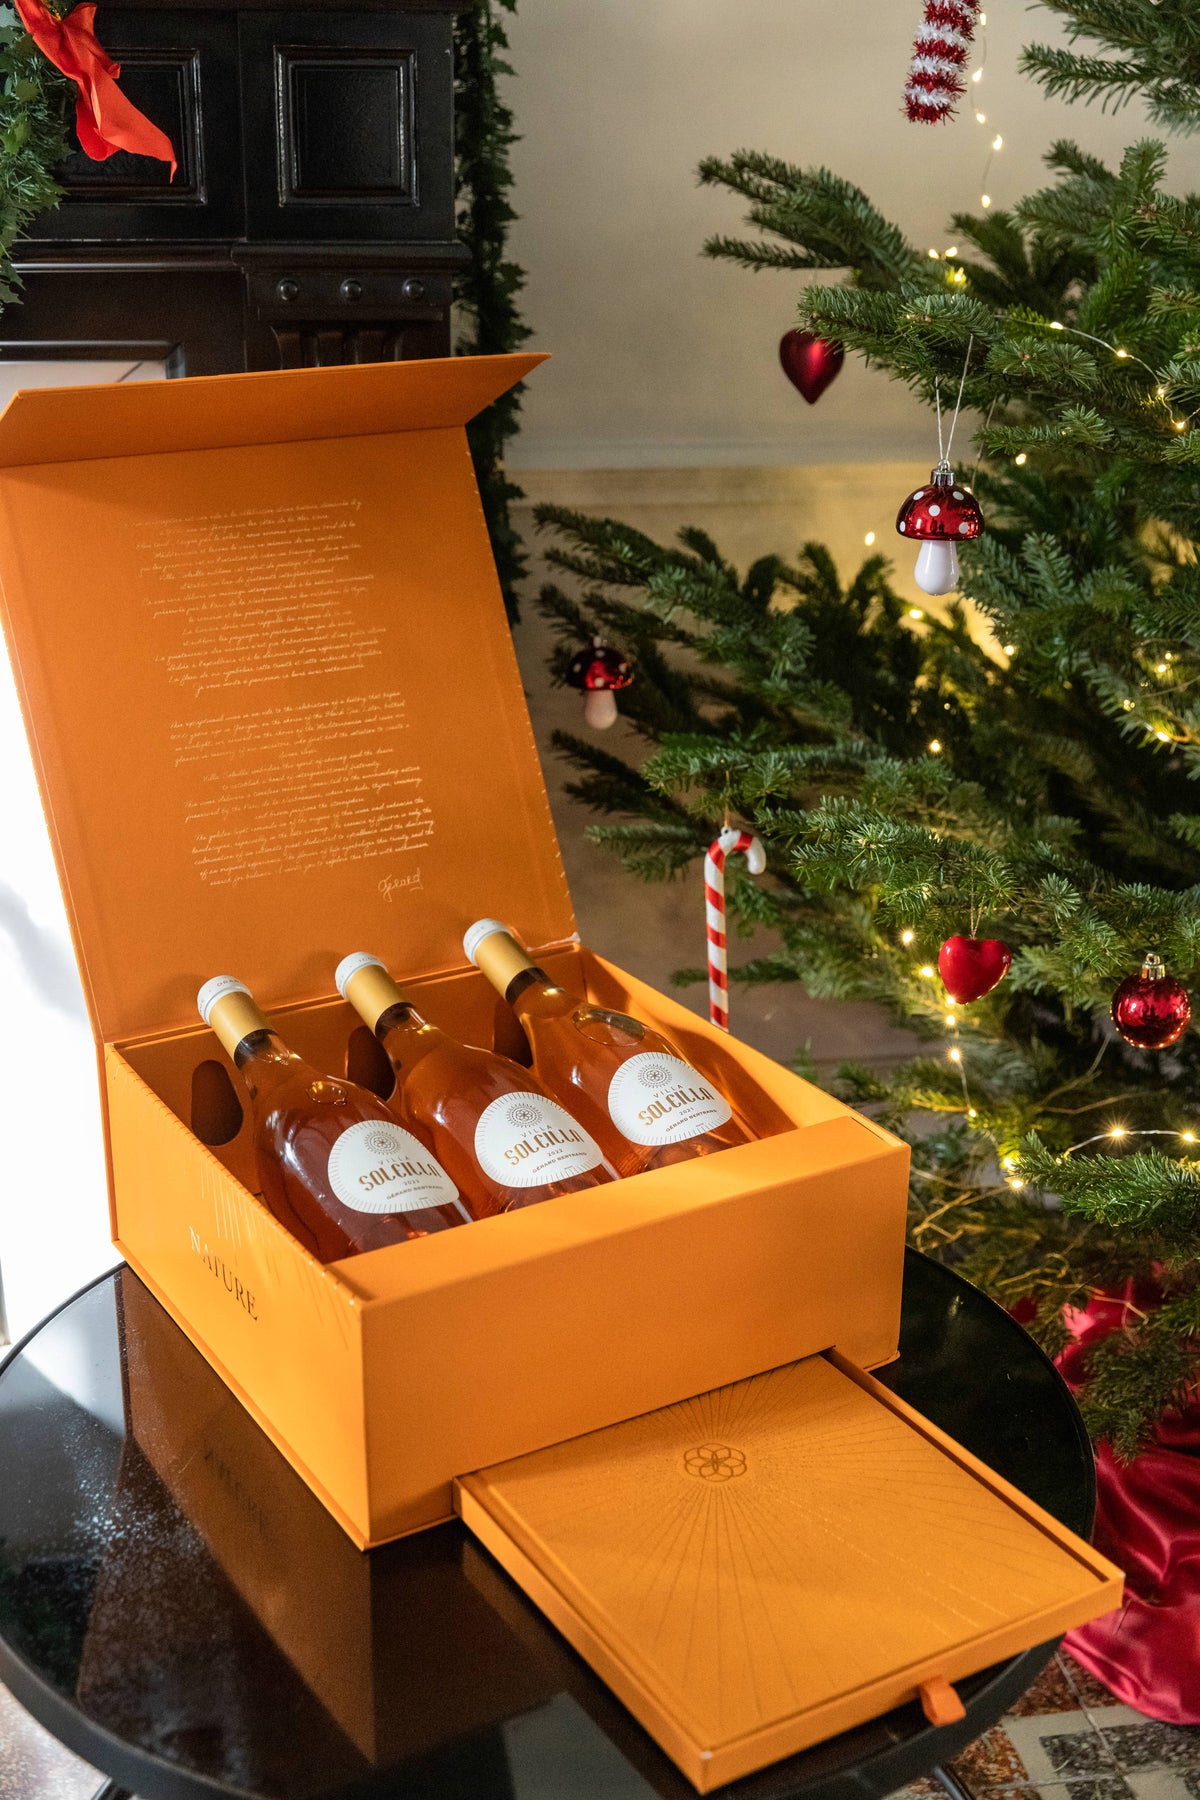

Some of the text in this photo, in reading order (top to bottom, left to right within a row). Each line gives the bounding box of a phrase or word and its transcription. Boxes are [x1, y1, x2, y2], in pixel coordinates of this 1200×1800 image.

[653, 1084, 684, 1098] VILLA
[521, 1125, 553, 1137] VILLA
[377, 1156, 410, 1165] VILLA
[188, 1225, 258, 1321] NATURE
